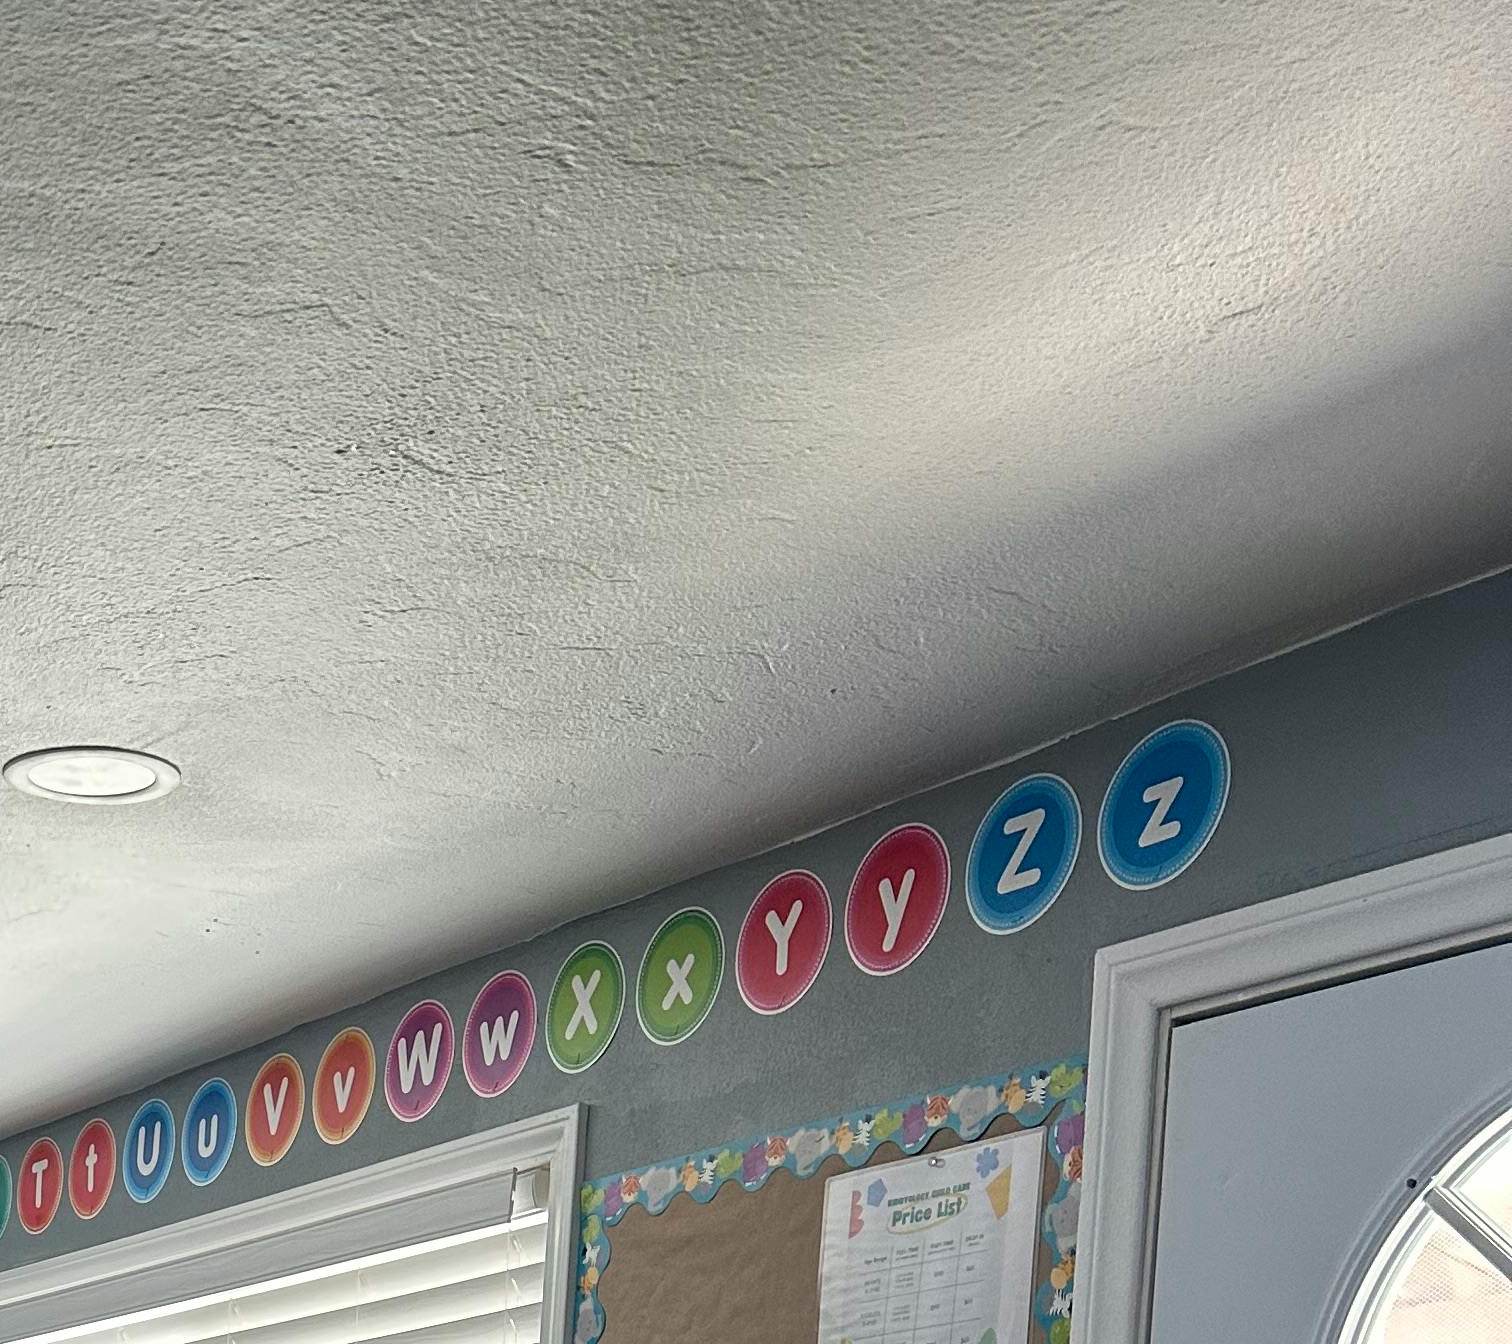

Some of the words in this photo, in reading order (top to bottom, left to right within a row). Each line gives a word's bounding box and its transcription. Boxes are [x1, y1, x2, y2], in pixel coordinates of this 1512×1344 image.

[31, 1159, 49, 1210] T
[85, 1143, 99, 1194] t
[136, 1121, 162, 1177] U
[263, 1077, 289, 1137] V
[397, 1022, 444, 1095] W
[565, 970, 602, 1041] X
[764, 900, 803, 976] Y
[877, 867, 916, 952] y
[996, 807, 1046, 895] Z
[891, 1205, 933, 1227] Price
[937, 1197, 963, 1218] List
